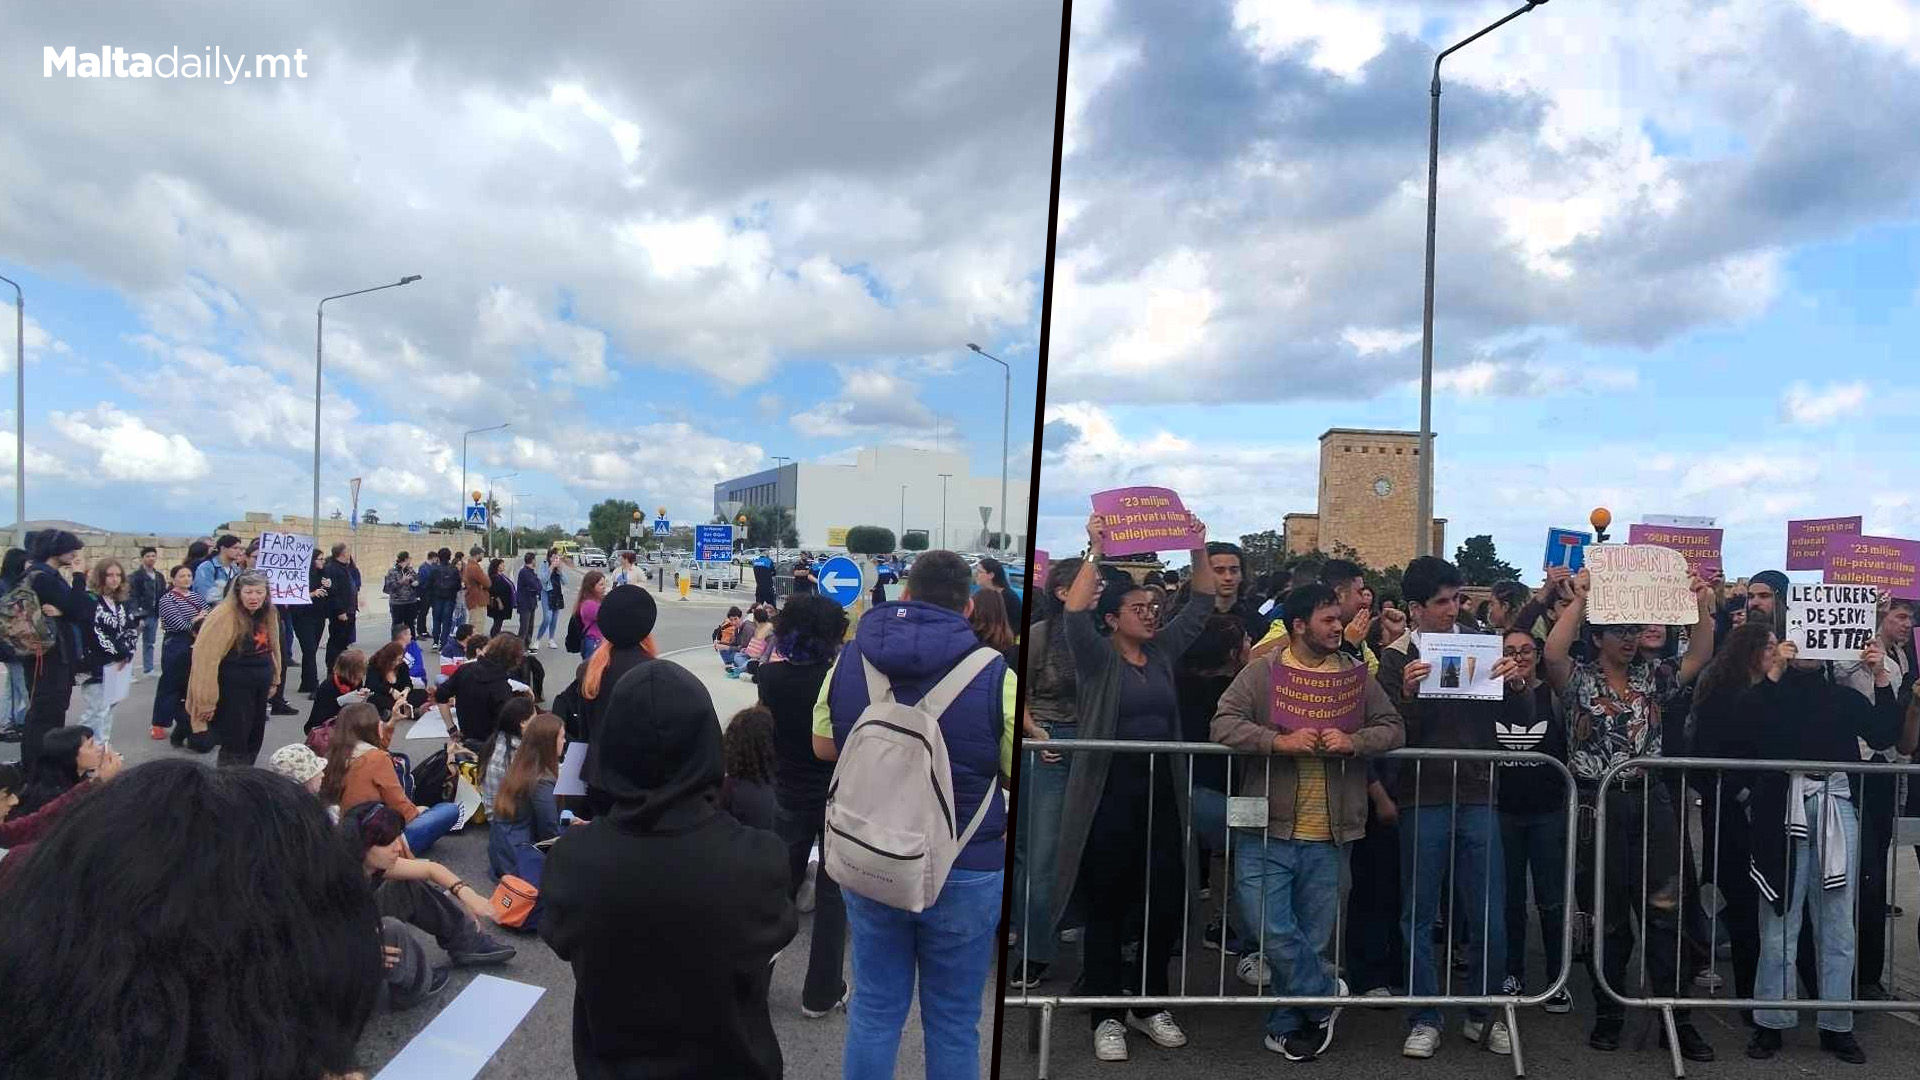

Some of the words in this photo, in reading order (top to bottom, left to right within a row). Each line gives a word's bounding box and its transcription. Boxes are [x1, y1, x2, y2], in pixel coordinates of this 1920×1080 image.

[262, 532, 295, 551] FAIR
[295, 541, 314, 553] PAY
[1671, 534, 1711, 546] FUTURE
[1695, 549, 1720, 558] HELD
[277, 570, 306, 582] MORE
[1599, 573, 1628, 583] WIN
[1650, 573, 1681, 585] WHEN
[1792, 585, 1878, 605] LECTURERS
[1805, 628, 1873, 651] BETTER
[1332, 677, 1343, 687] in
[1275, 697, 1286, 709] in
[1287, 703, 1308, 716] our
